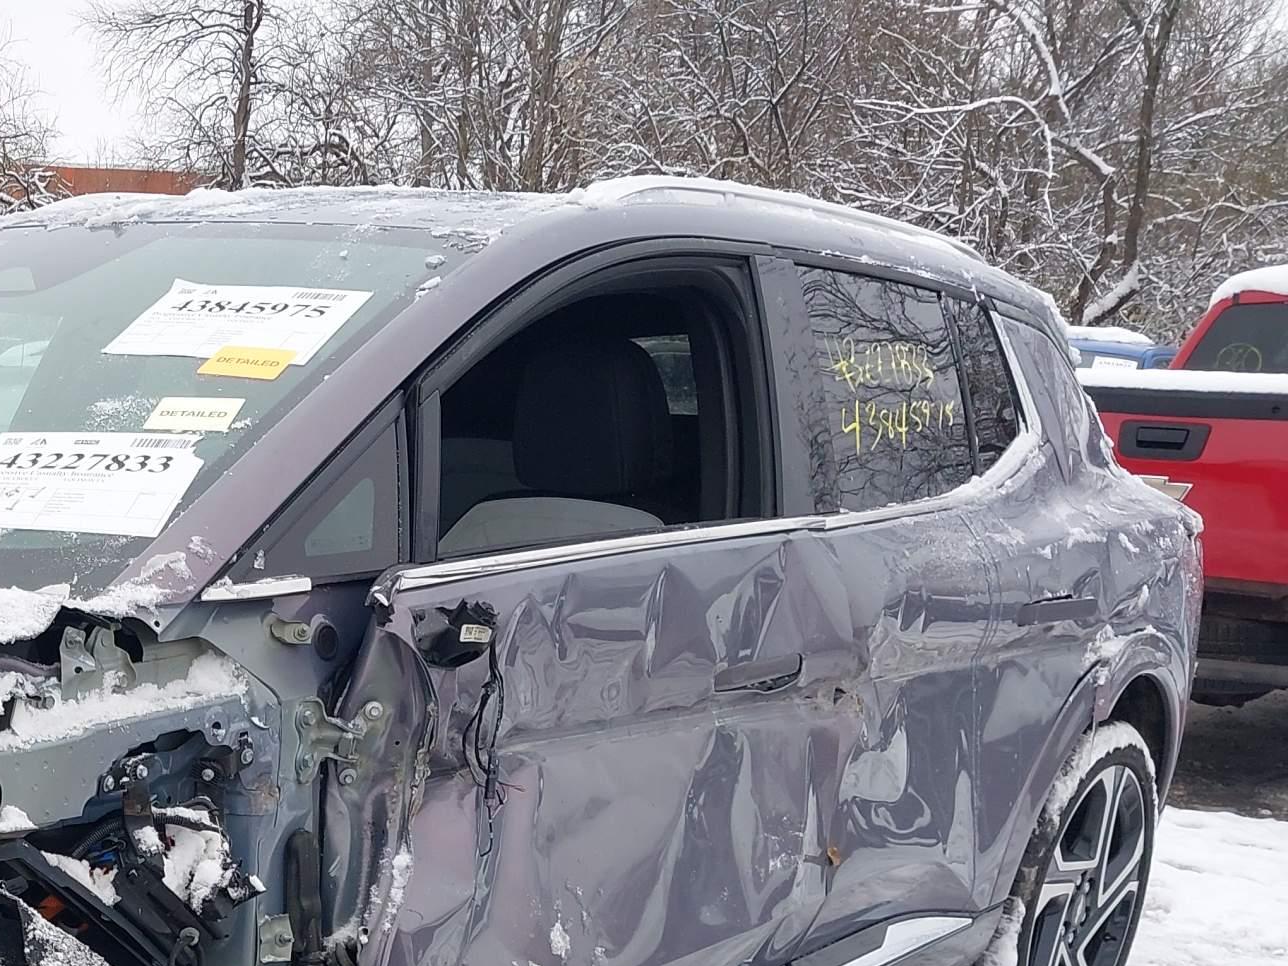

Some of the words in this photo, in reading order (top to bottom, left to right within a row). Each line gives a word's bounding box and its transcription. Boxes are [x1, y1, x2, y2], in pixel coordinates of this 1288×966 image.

[171, 299, 332, 318] 43845975
[215, 356, 281, 368] DETAILED
[159, 410, 228, 418] DETAILED
